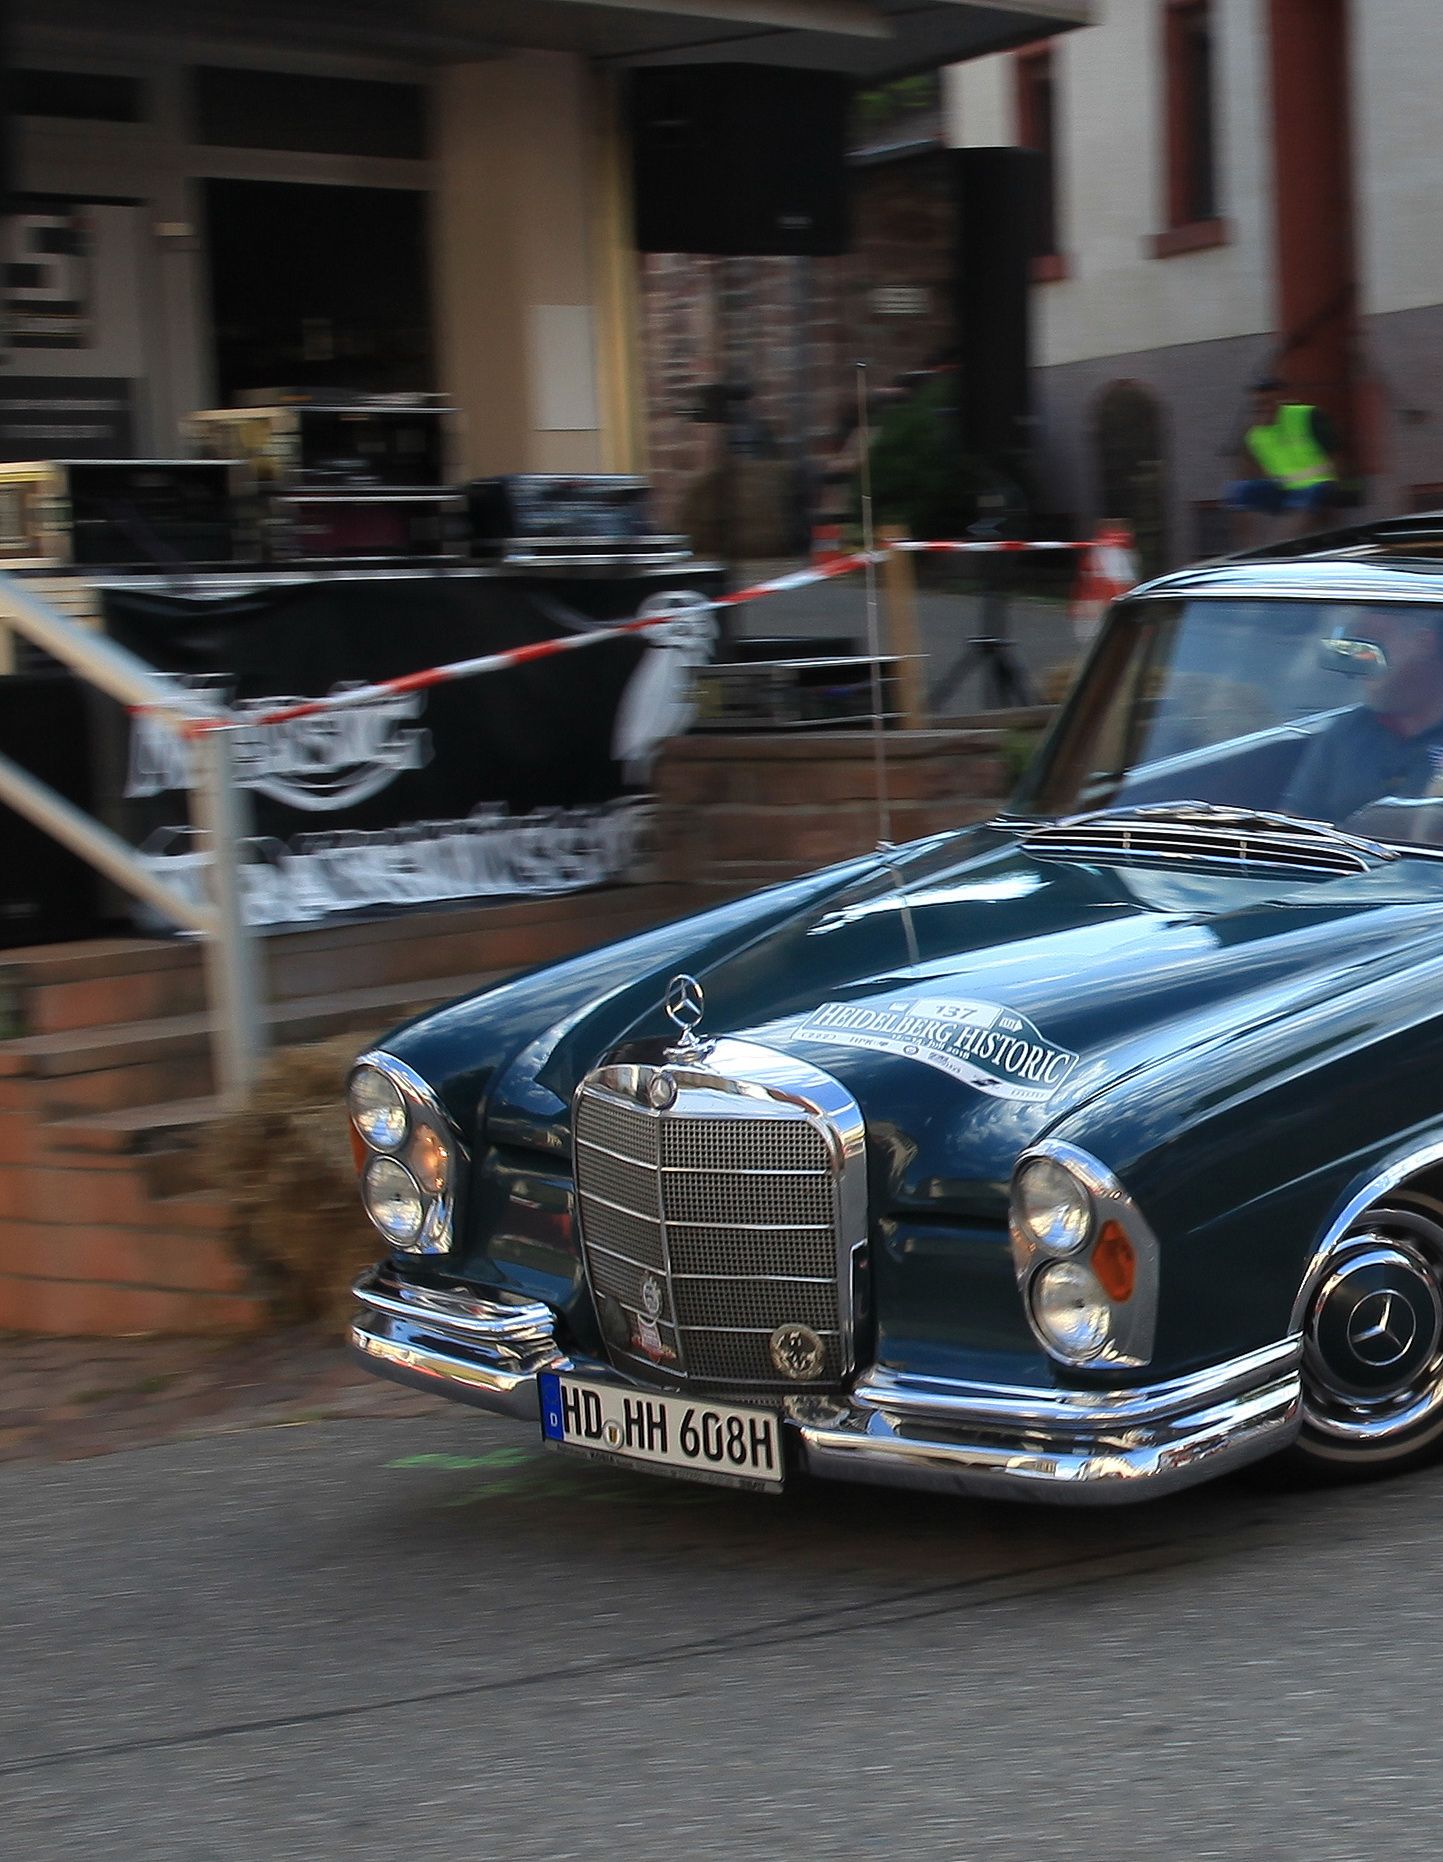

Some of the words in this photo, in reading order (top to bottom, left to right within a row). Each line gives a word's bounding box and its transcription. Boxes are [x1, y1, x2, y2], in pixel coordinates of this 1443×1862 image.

[933, 1002, 978, 1018] 137
[814, 1003, 956, 1042] HEIDELBERG
[956, 1026, 1069, 1085] HISTORIC
[550, 1412, 558, 1427] D
[561, 1385, 602, 1440] HD
[624, 1398, 667, 1453] HH
[680, 1408, 774, 1470] 608H
